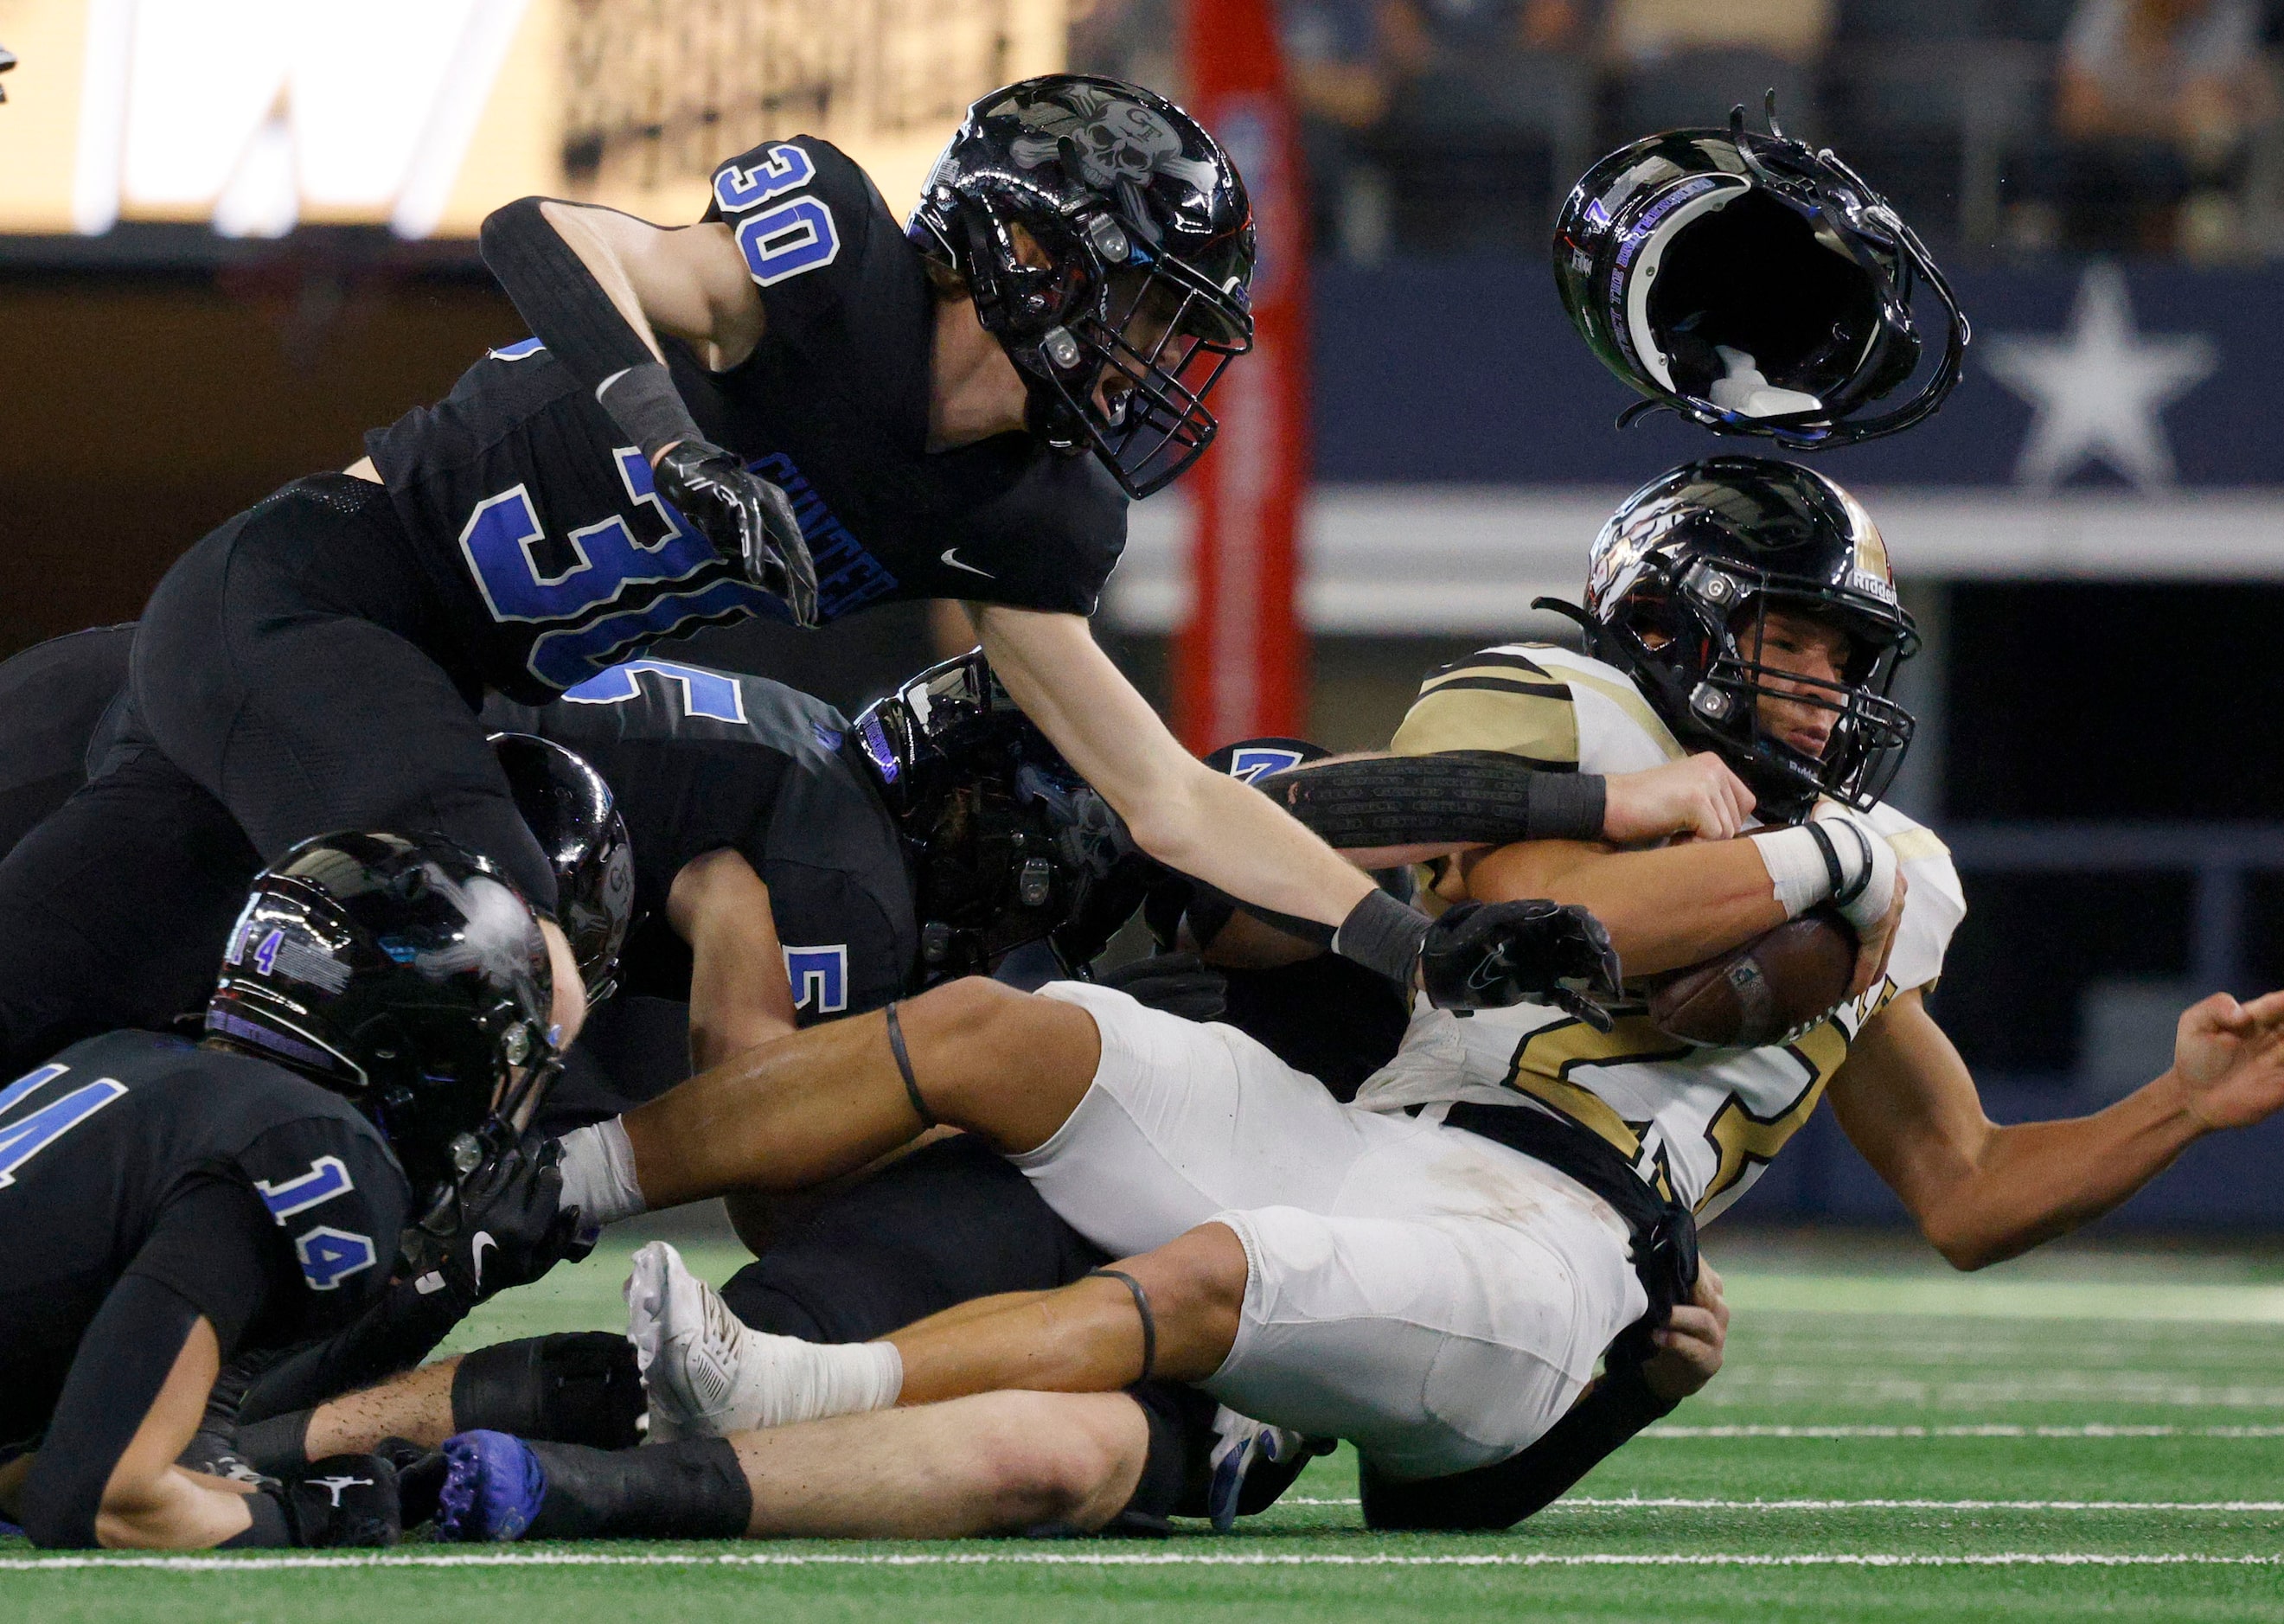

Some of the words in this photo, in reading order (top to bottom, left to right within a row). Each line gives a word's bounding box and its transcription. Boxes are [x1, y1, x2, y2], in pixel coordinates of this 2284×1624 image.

[713, 144, 841, 287] 30
[1583, 197, 1612, 233] 7
[229, 920, 285, 977] 14
[253, 1155, 377, 1290] 14
